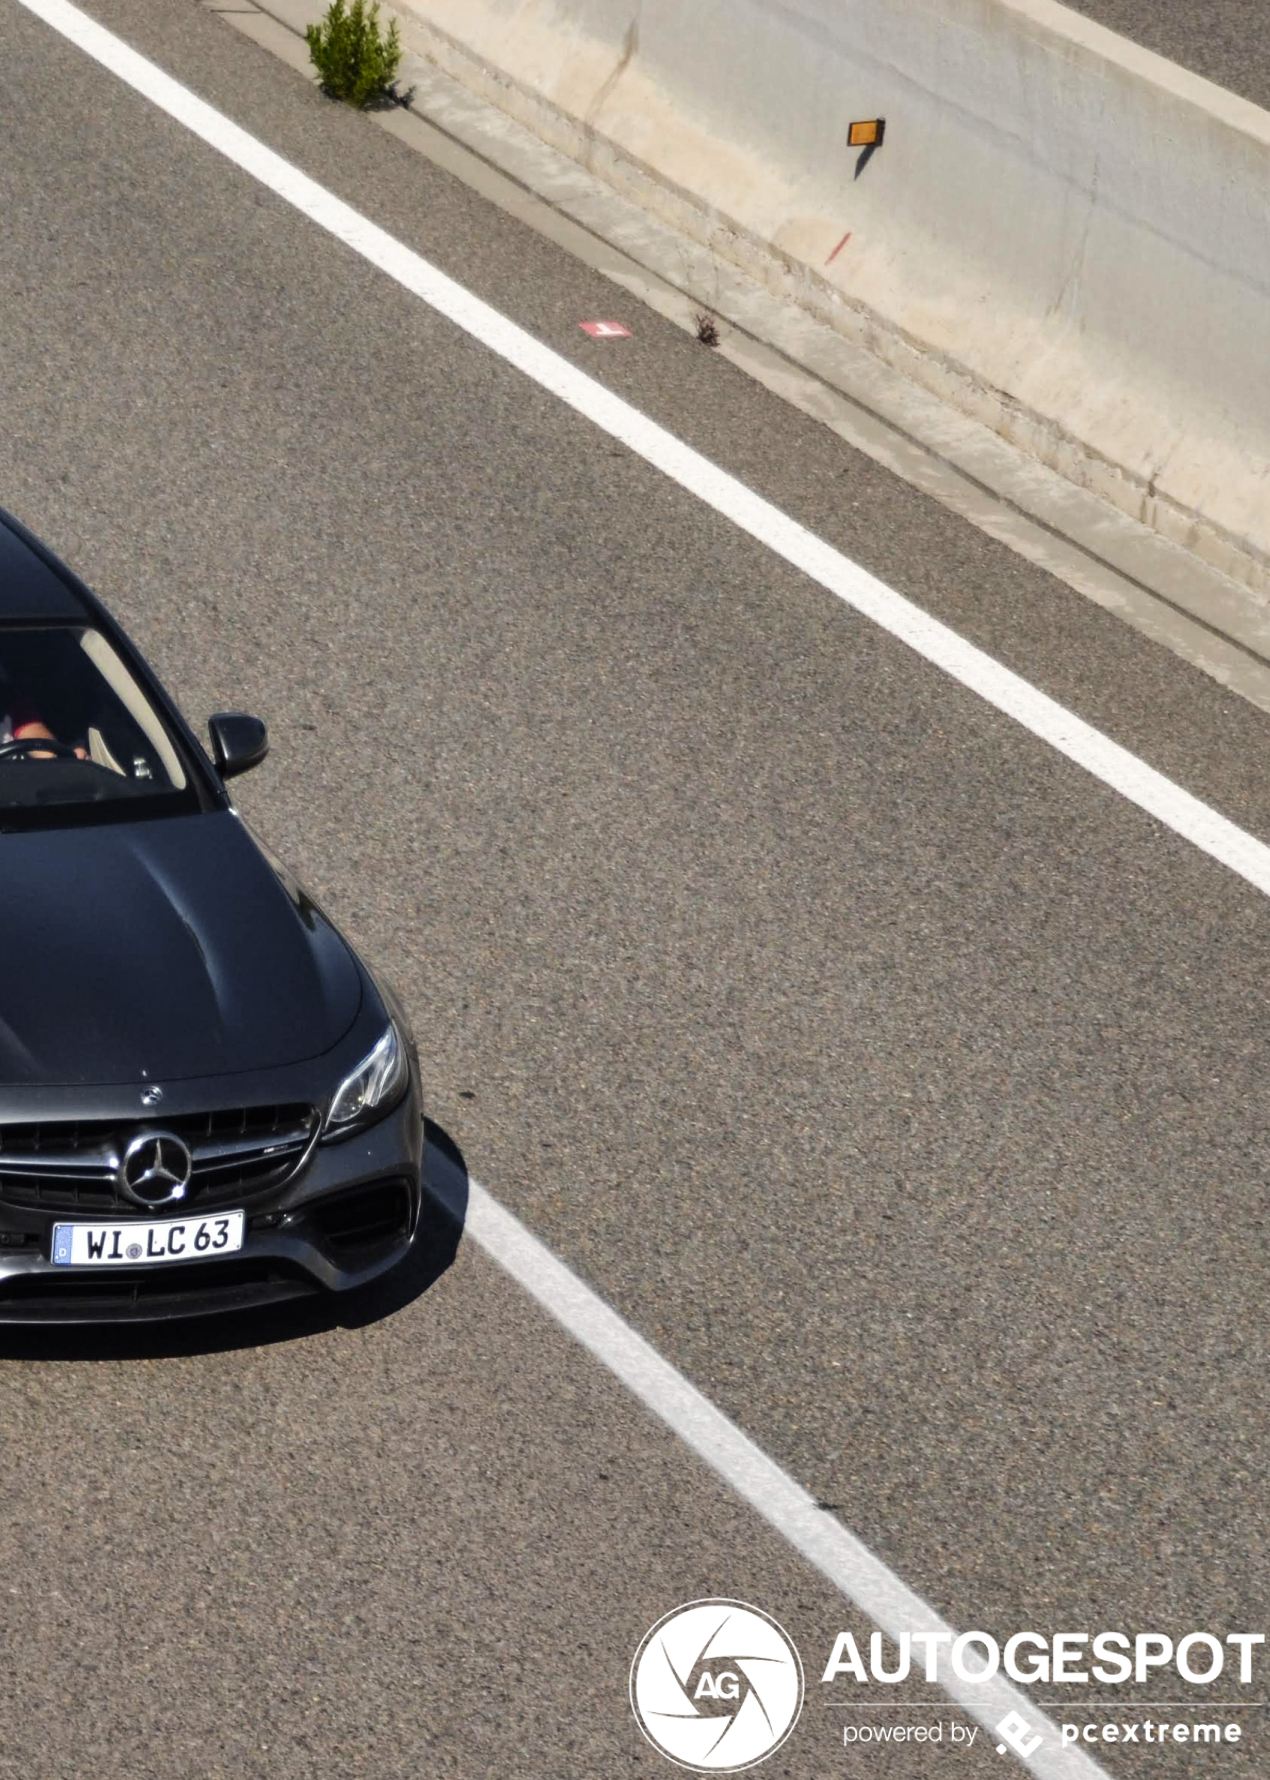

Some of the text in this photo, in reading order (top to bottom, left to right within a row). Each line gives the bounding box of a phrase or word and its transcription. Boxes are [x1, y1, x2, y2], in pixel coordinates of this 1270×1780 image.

[59, 1219, 229, 1259] D WI LC 63
